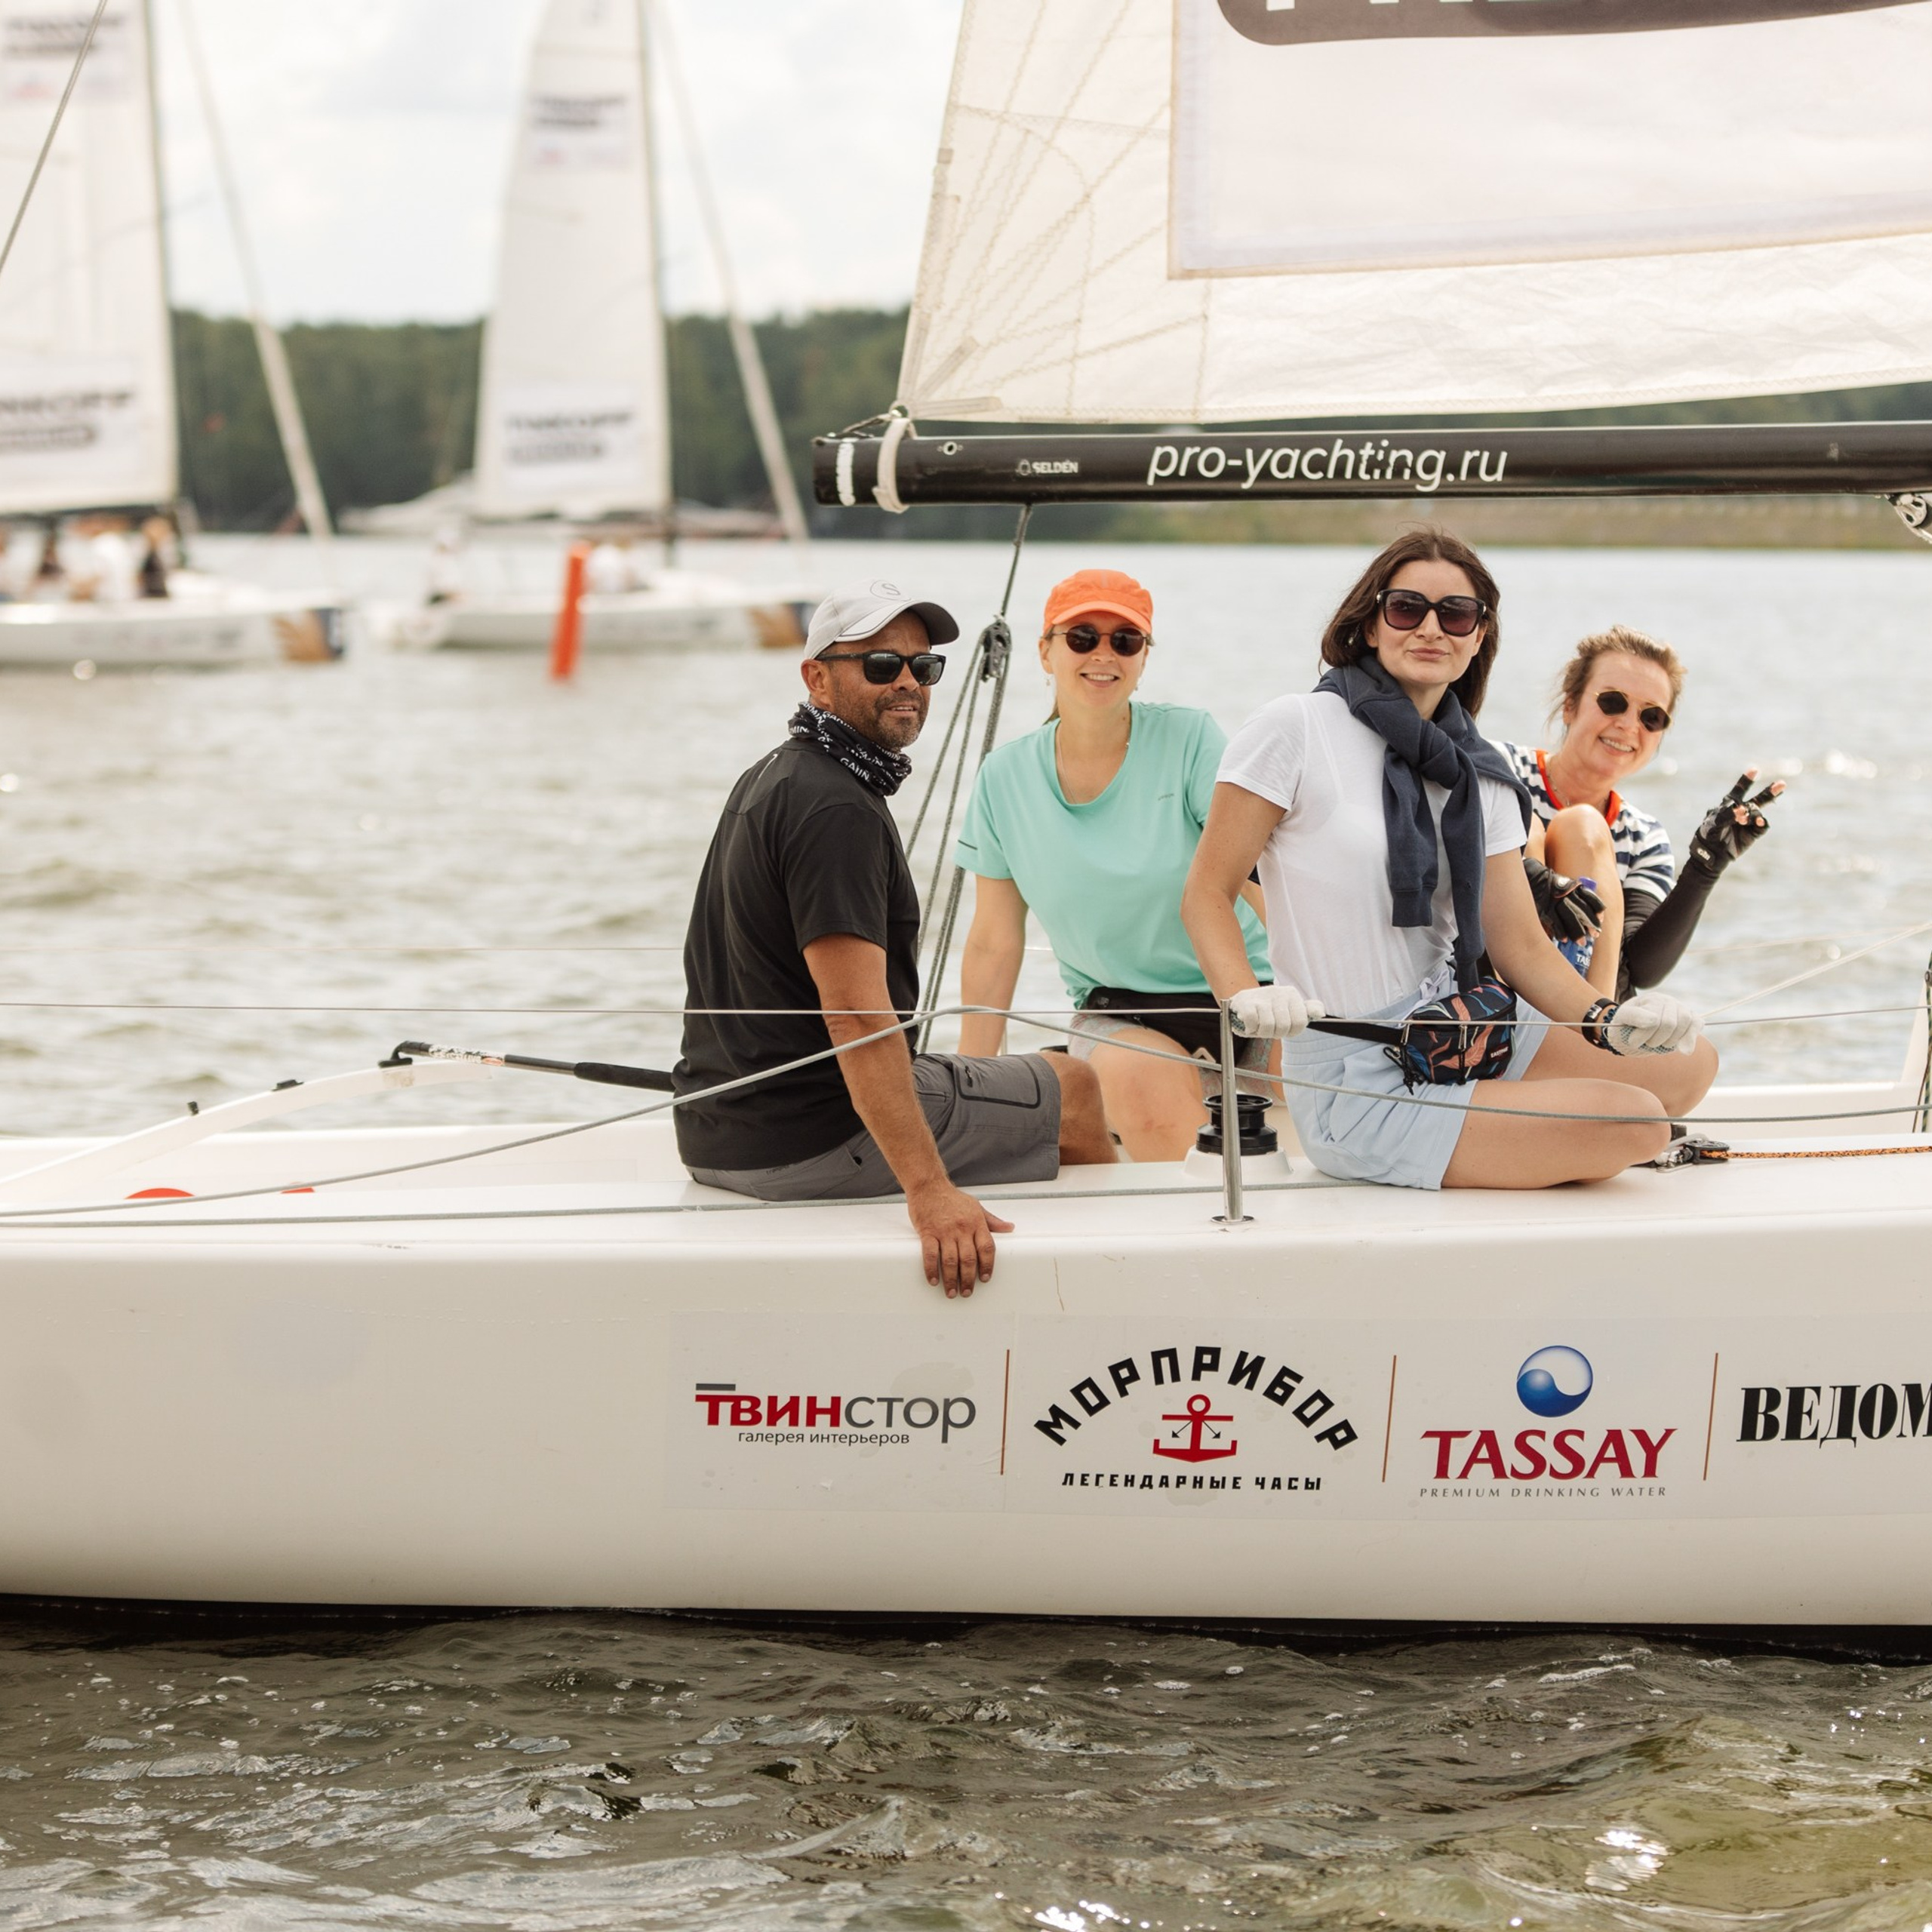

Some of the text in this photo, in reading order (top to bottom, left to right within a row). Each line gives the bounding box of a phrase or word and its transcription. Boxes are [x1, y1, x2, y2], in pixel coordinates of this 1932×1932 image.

[1146, 438, 1508, 493] pro-yachting.ru
[1033, 1345, 1358, 1451] МОРПРИБОР
[1736, 1383, 1932, 1449] ВЕДОМ
[738, 1432, 910, 1447] галерея интерьеров
[1420, 1428, 1678, 1481] TASSAY
[1061, 1472, 1321, 1491] ЛЕГЕНДАРНЫЕ ЧАСЫ
[1420, 1487, 1666, 1498] PREMIUM DRINKING WATER
